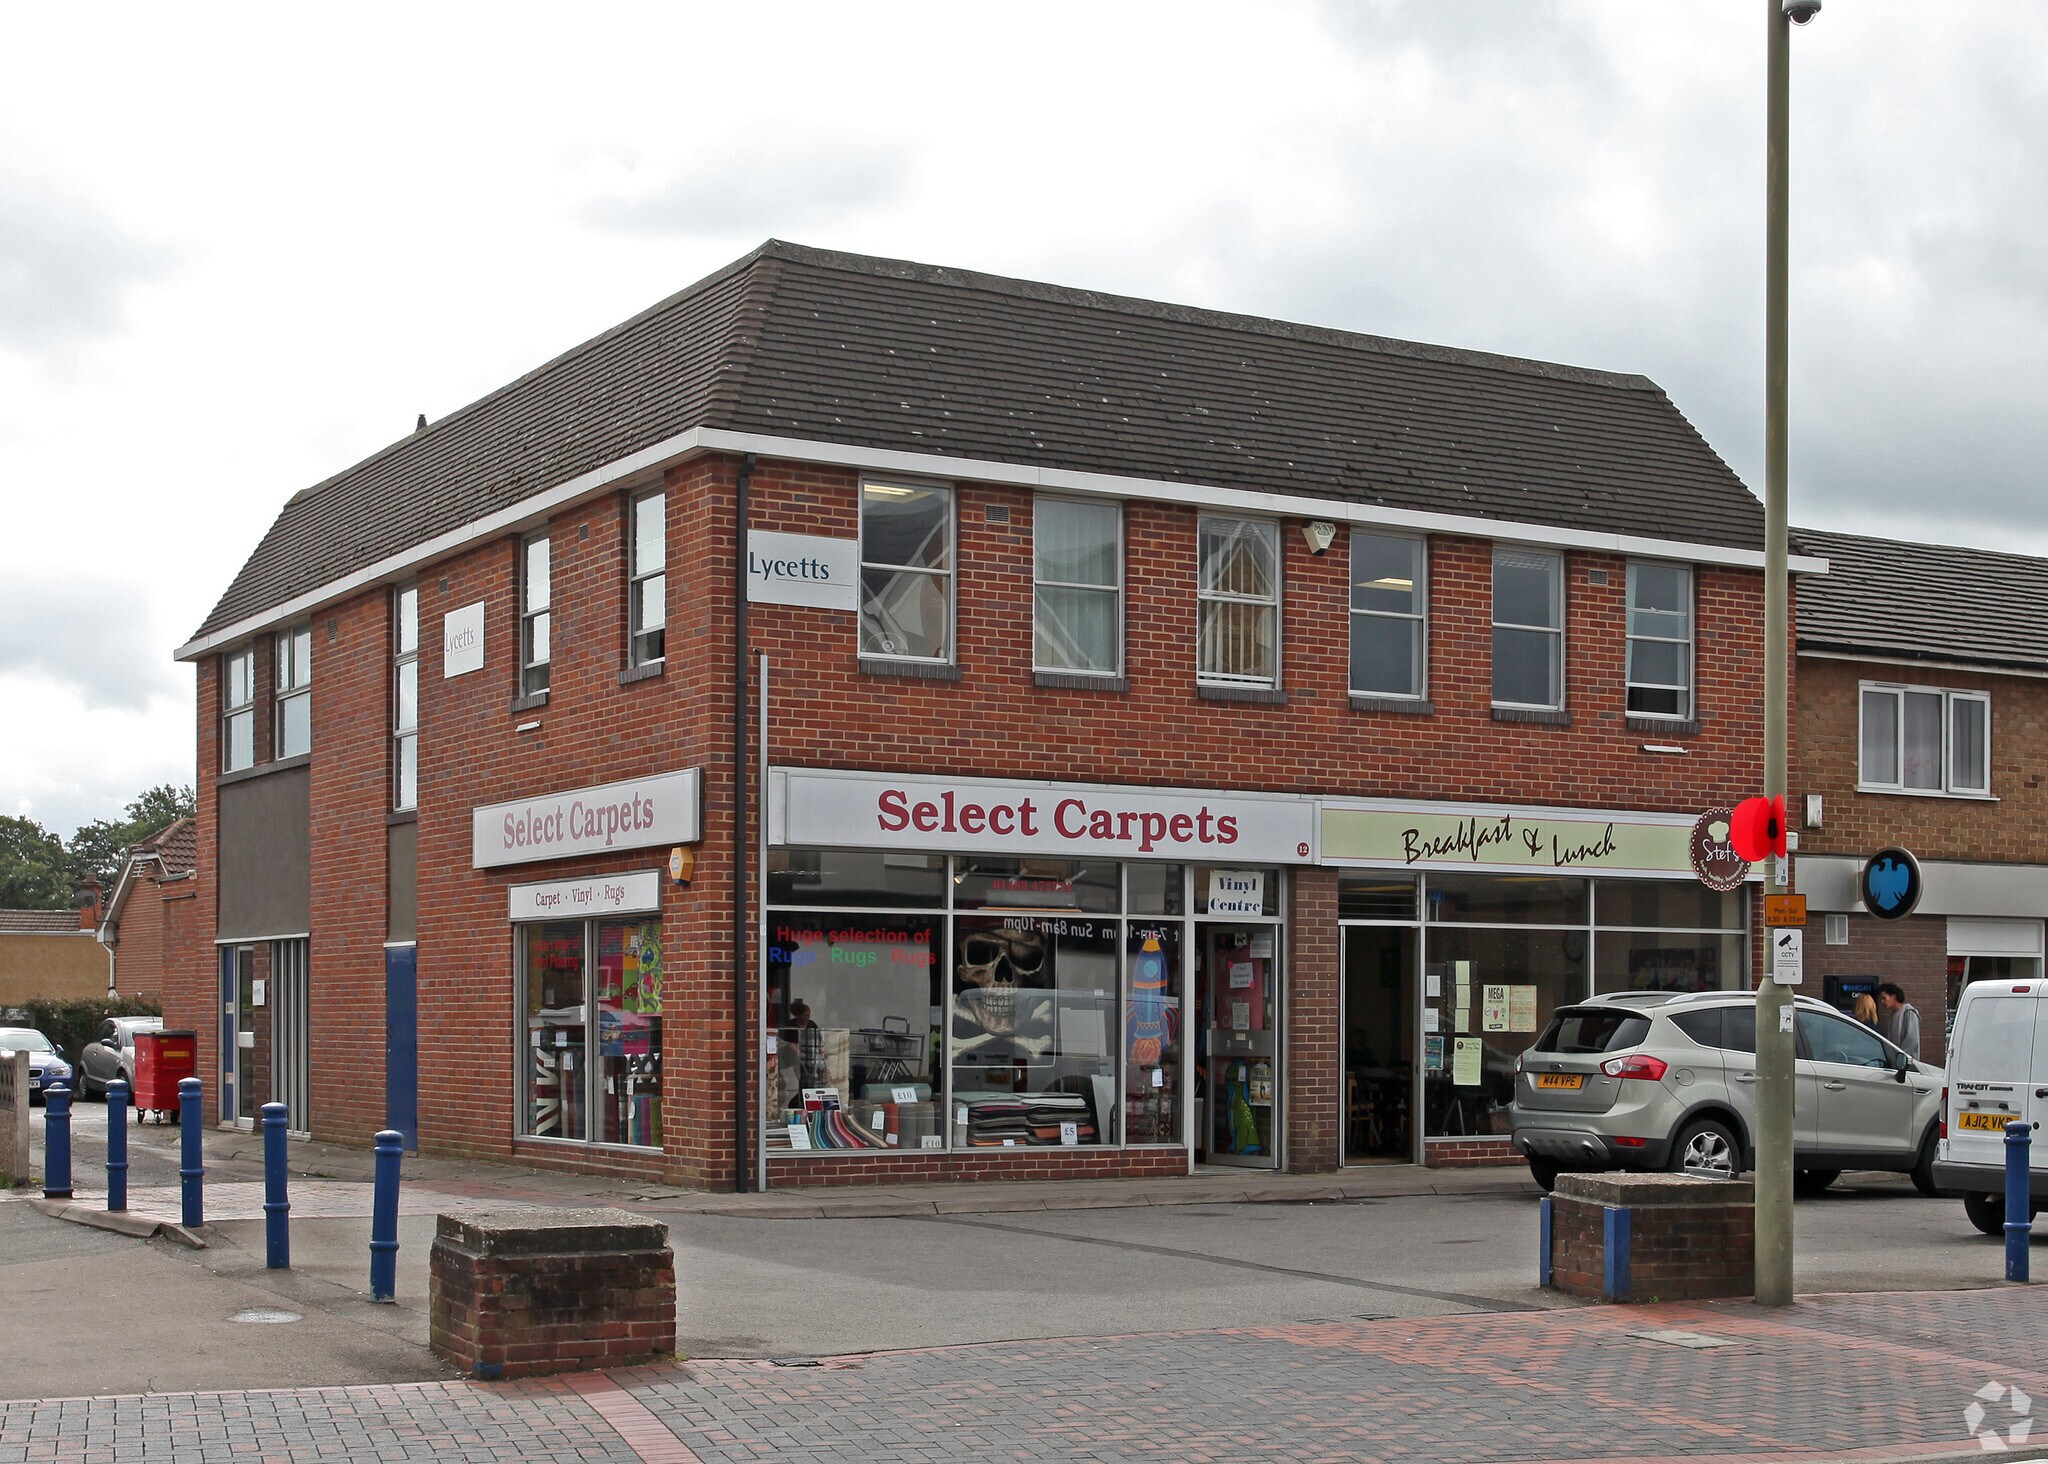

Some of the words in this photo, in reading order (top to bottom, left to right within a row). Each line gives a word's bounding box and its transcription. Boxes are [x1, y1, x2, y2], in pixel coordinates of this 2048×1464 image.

[750, 552, 830, 580] Lycetts
[446, 627, 475, 657] Lycetts
[503, 805, 564, 849] Select
[570, 791, 654, 845] Carpets
[877, 789, 1039, 836] Select
[1053, 798, 1239, 852] Carpets
[1299, 845, 1308, 853] 12
[1401, 814, 1512, 865] Breakfast
[1522, 827, 1544, 857] &
[1552, 822, 1616, 867] Lunch
[1702, 838, 1740, 862] Stefs
[1219, 877, 1257, 895] Vinyl
[535, 891, 561, 909] Carpet
[572, 886, 593, 906] Vinyl
[604, 884, 625, 905] Rugs
[1210, 897, 1260, 912] Centre
[776, 926, 824, 947] Huge
[828, 927, 909, 943] selection
[913, 928, 931, 944] of
[769, 946, 816, 967] Rugs
[831, 947, 877, 967] Rugs
[890, 947, 937, 968] Rugs
[1488, 987, 1504, 1000] MEGA
[1542, 1075, 1559, 1086] M44
[1561, 1075, 1576, 1086] VPE
[1956, 1083, 1989, 1091] TRANSIT
[897, 1091, 912, 1100] £10
[1064, 1127, 1074, 1136] £5
[1965, 1115, 1989, 1129] AJ12
[925, 1140, 940, 1148] £10
